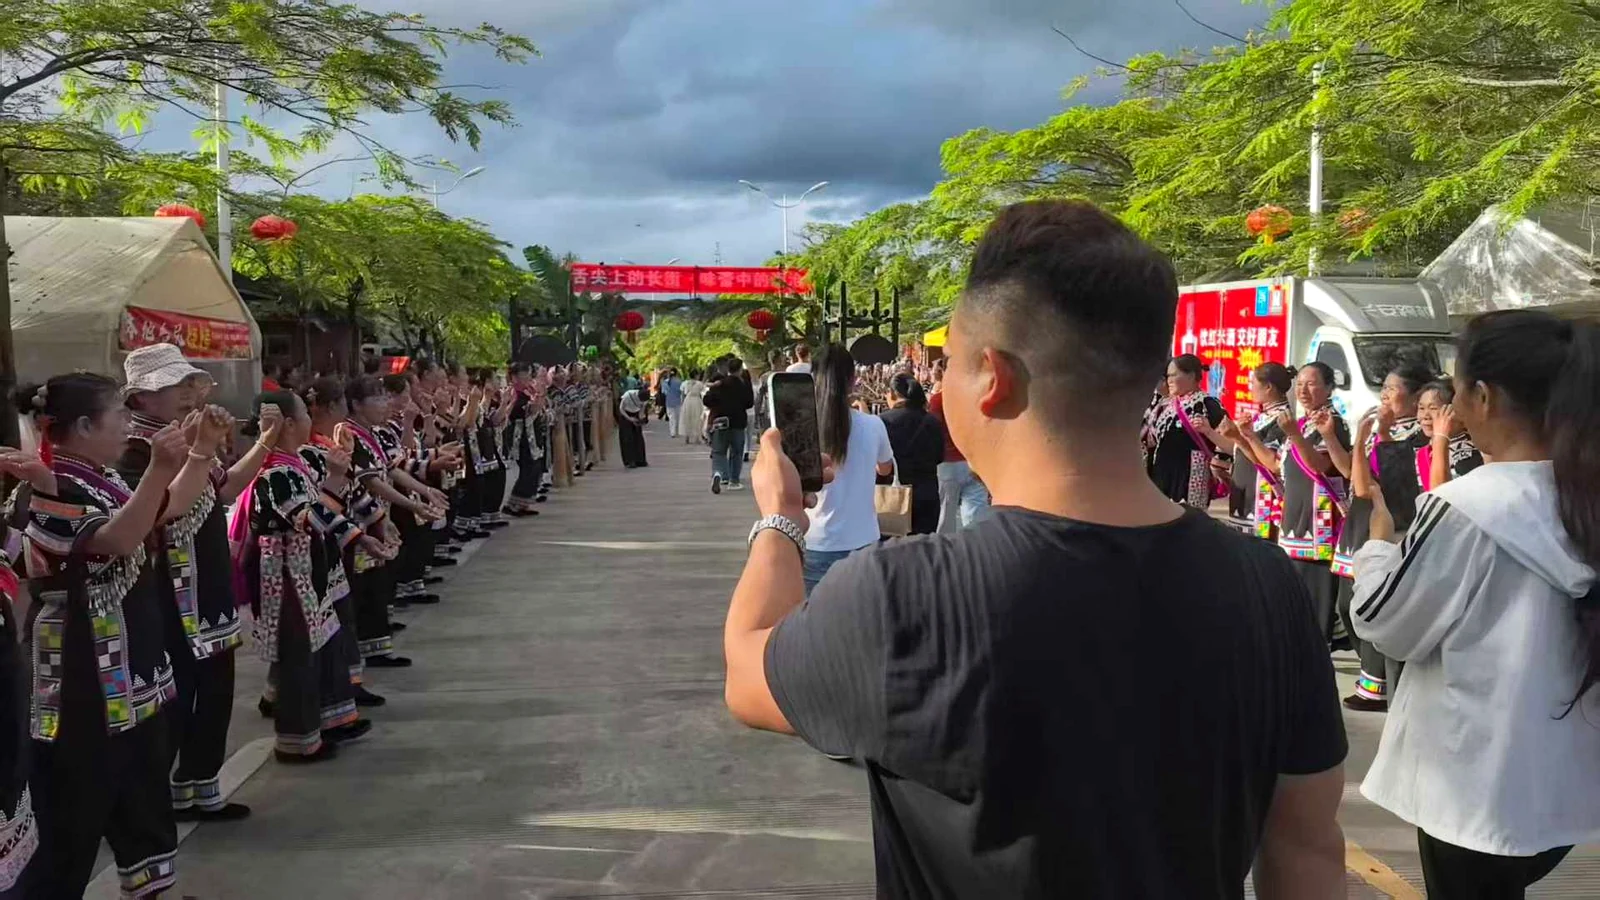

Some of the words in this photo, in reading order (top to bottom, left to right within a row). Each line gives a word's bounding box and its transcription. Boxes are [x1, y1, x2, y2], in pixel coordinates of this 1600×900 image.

[572, 267, 681, 287] 舌尖上的长街
